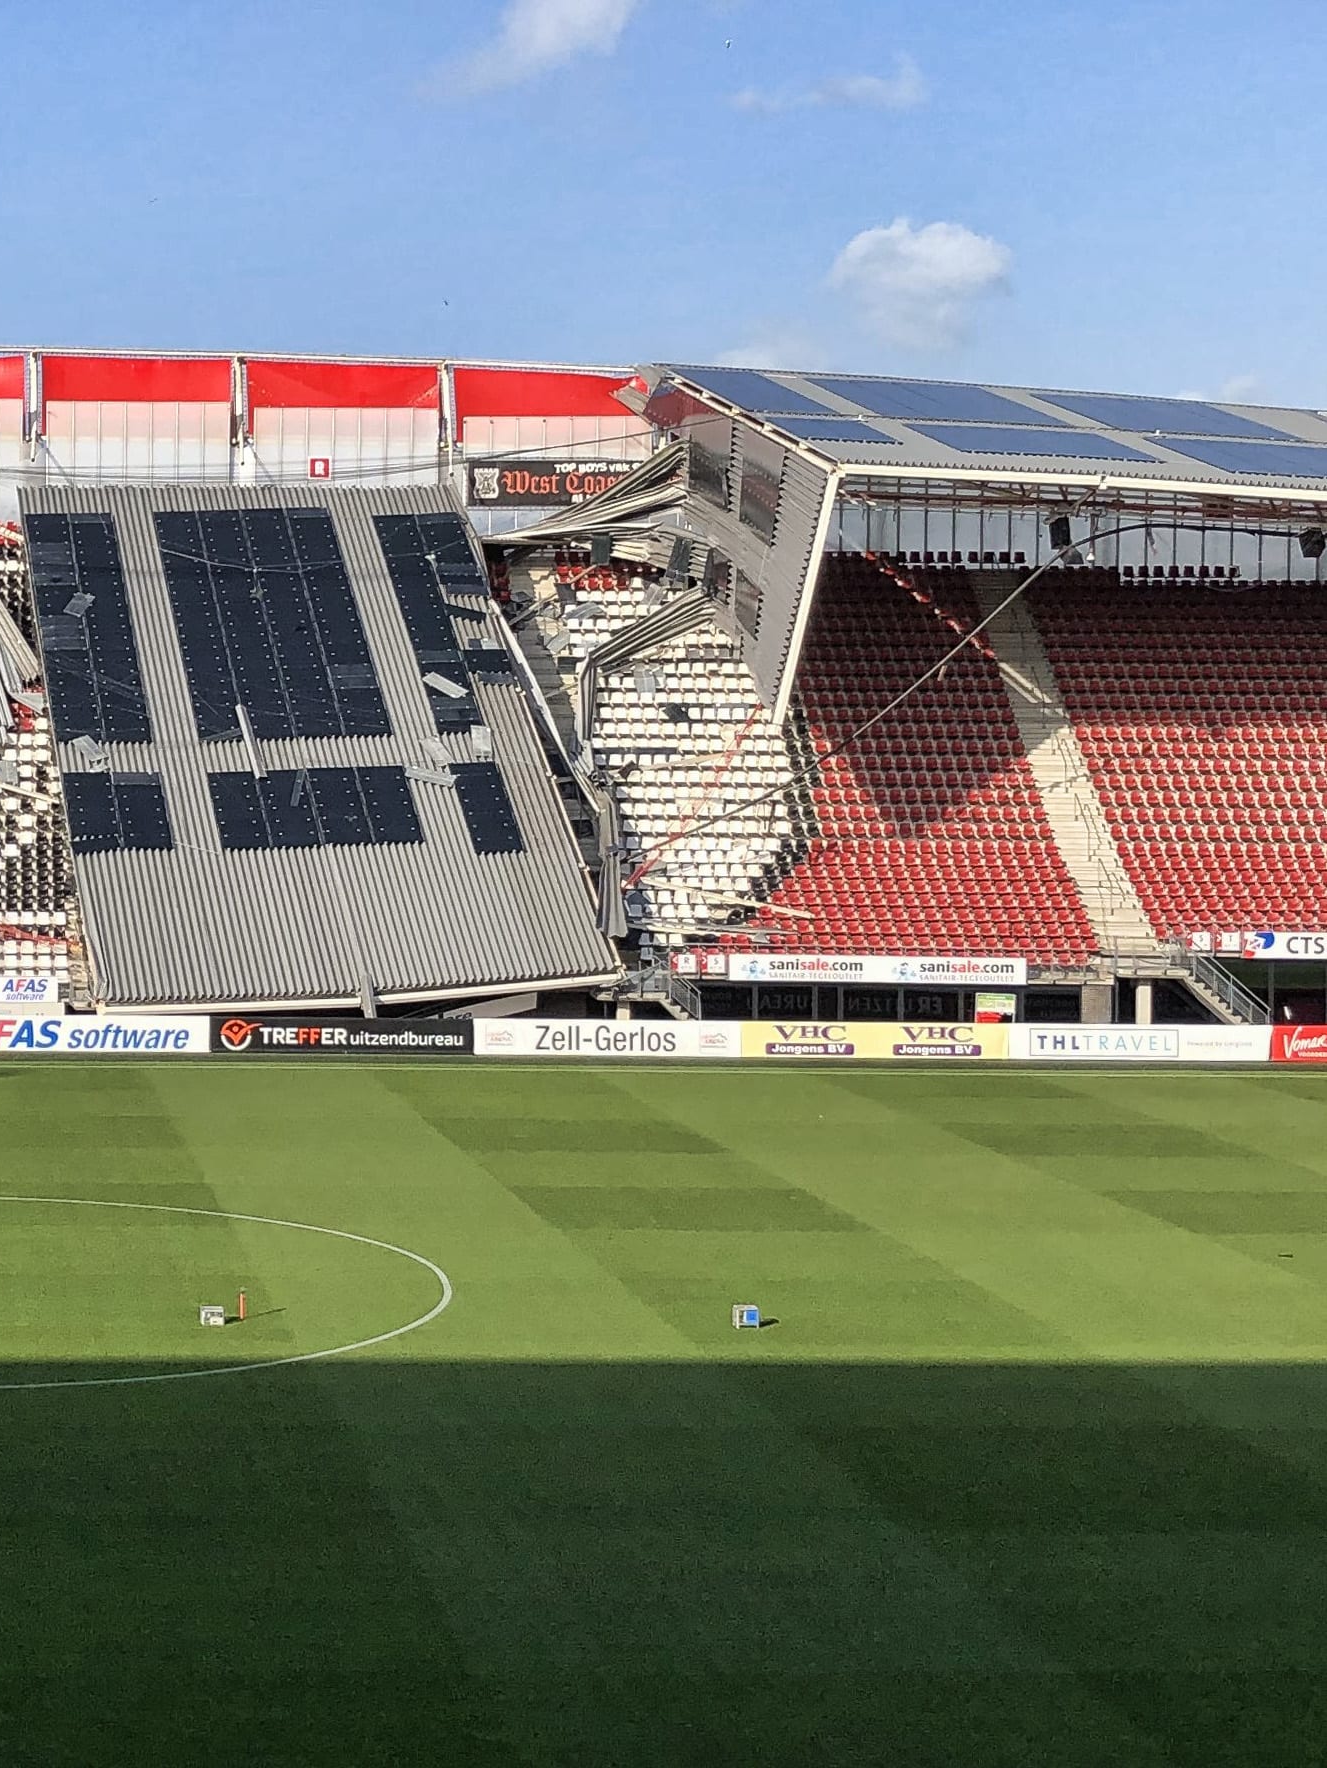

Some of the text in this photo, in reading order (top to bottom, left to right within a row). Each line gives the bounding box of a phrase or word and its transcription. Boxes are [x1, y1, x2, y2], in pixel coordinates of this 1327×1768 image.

[314, 460, 325, 475] R
[554, 462, 577, 473] TOP
[578, 462, 607, 473] BOYS
[501, 470, 619, 494] West Coas
[1286, 937, 1325, 954] CTS
[769, 958, 864, 971] sanisale.com
[919, 960, 1015, 973] sanisale.com
[2, 978, 49, 992] AFAS
[5, 992, 45, 1000] software
[67, 1023, 190, 1049] software
[259, 1027, 464, 1047] TREFFER uitzendbureau
[535, 1025, 677, 1052] Zell-Gerlos
[773, 1025, 848, 1042] VHC
[899, 1025, 975, 1043] VHC
[771, 1043, 847, 1055] Jongens BV
[898, 1044, 974, 1056] Jongens BV
